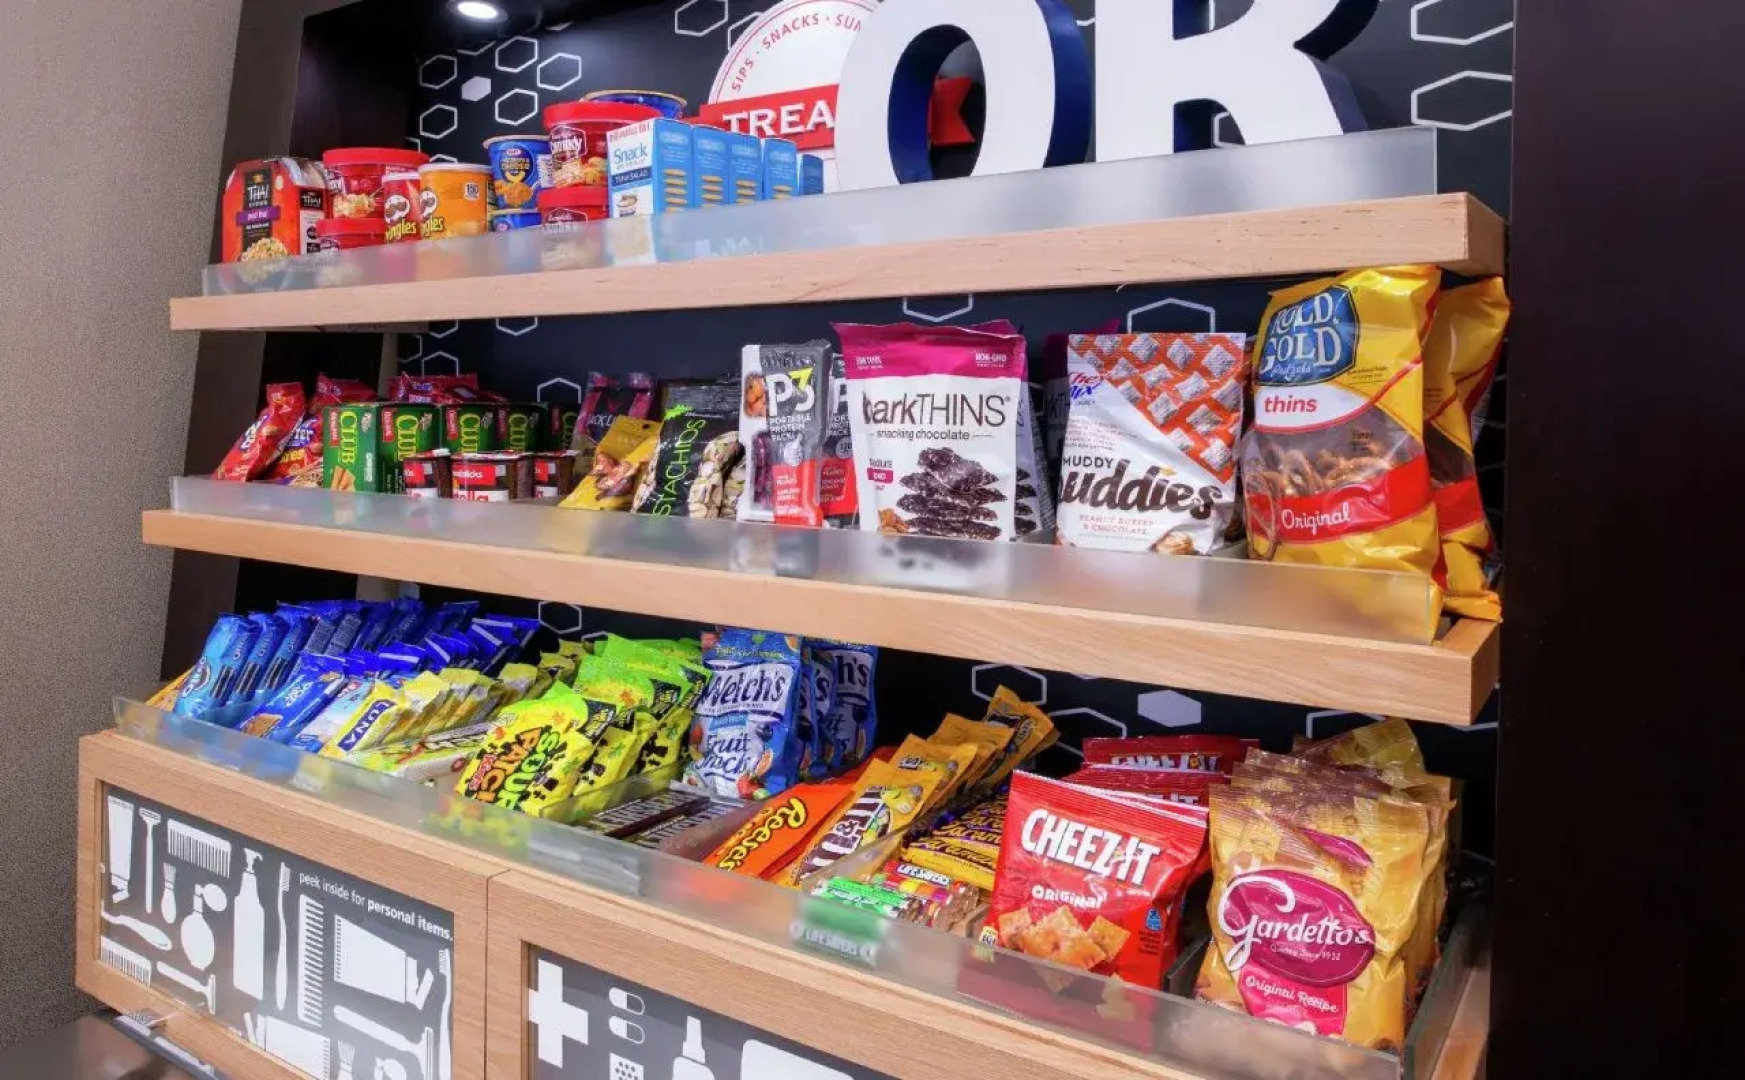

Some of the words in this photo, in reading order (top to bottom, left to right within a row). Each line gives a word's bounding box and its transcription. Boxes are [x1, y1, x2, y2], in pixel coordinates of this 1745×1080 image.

[731, 59, 754, 92] SIPS
[762, 13, 820, 50] SNACKS
[614, 143, 647, 164] Snack
[1261, 326, 1342, 373] GOLD
[766, 368, 815, 416] P3
[862, 392, 1006, 427] barkTHINS
[1264, 395, 1317, 413] thins
[339, 411, 358, 464] CLUB
[460, 414, 480, 453] CLU
[770, 424, 805, 432] PROTEIN
[876, 429, 914, 440] snacking
[915, 429, 970, 440] chocolate
[1282, 502, 1351, 534] Original
[700, 670, 785, 706] Welch's
[707, 732, 750, 753] Fruit
[498, 730, 561, 810] SOUR
[717, 796, 808, 872] Reese's
[1021, 808, 1160, 886] CHEEZ-IT
[300, 872, 321, 889] peek
[322, 878, 350, 900] inside
[351, 889, 366, 906] for
[367, 899, 416, 926] personal
[417, 915, 454, 942] items.
[1218, 873, 1370, 972] Gardetto's
[1245, 974, 1296, 1000] Original
[1297, 990, 1338, 1013] Recipe
